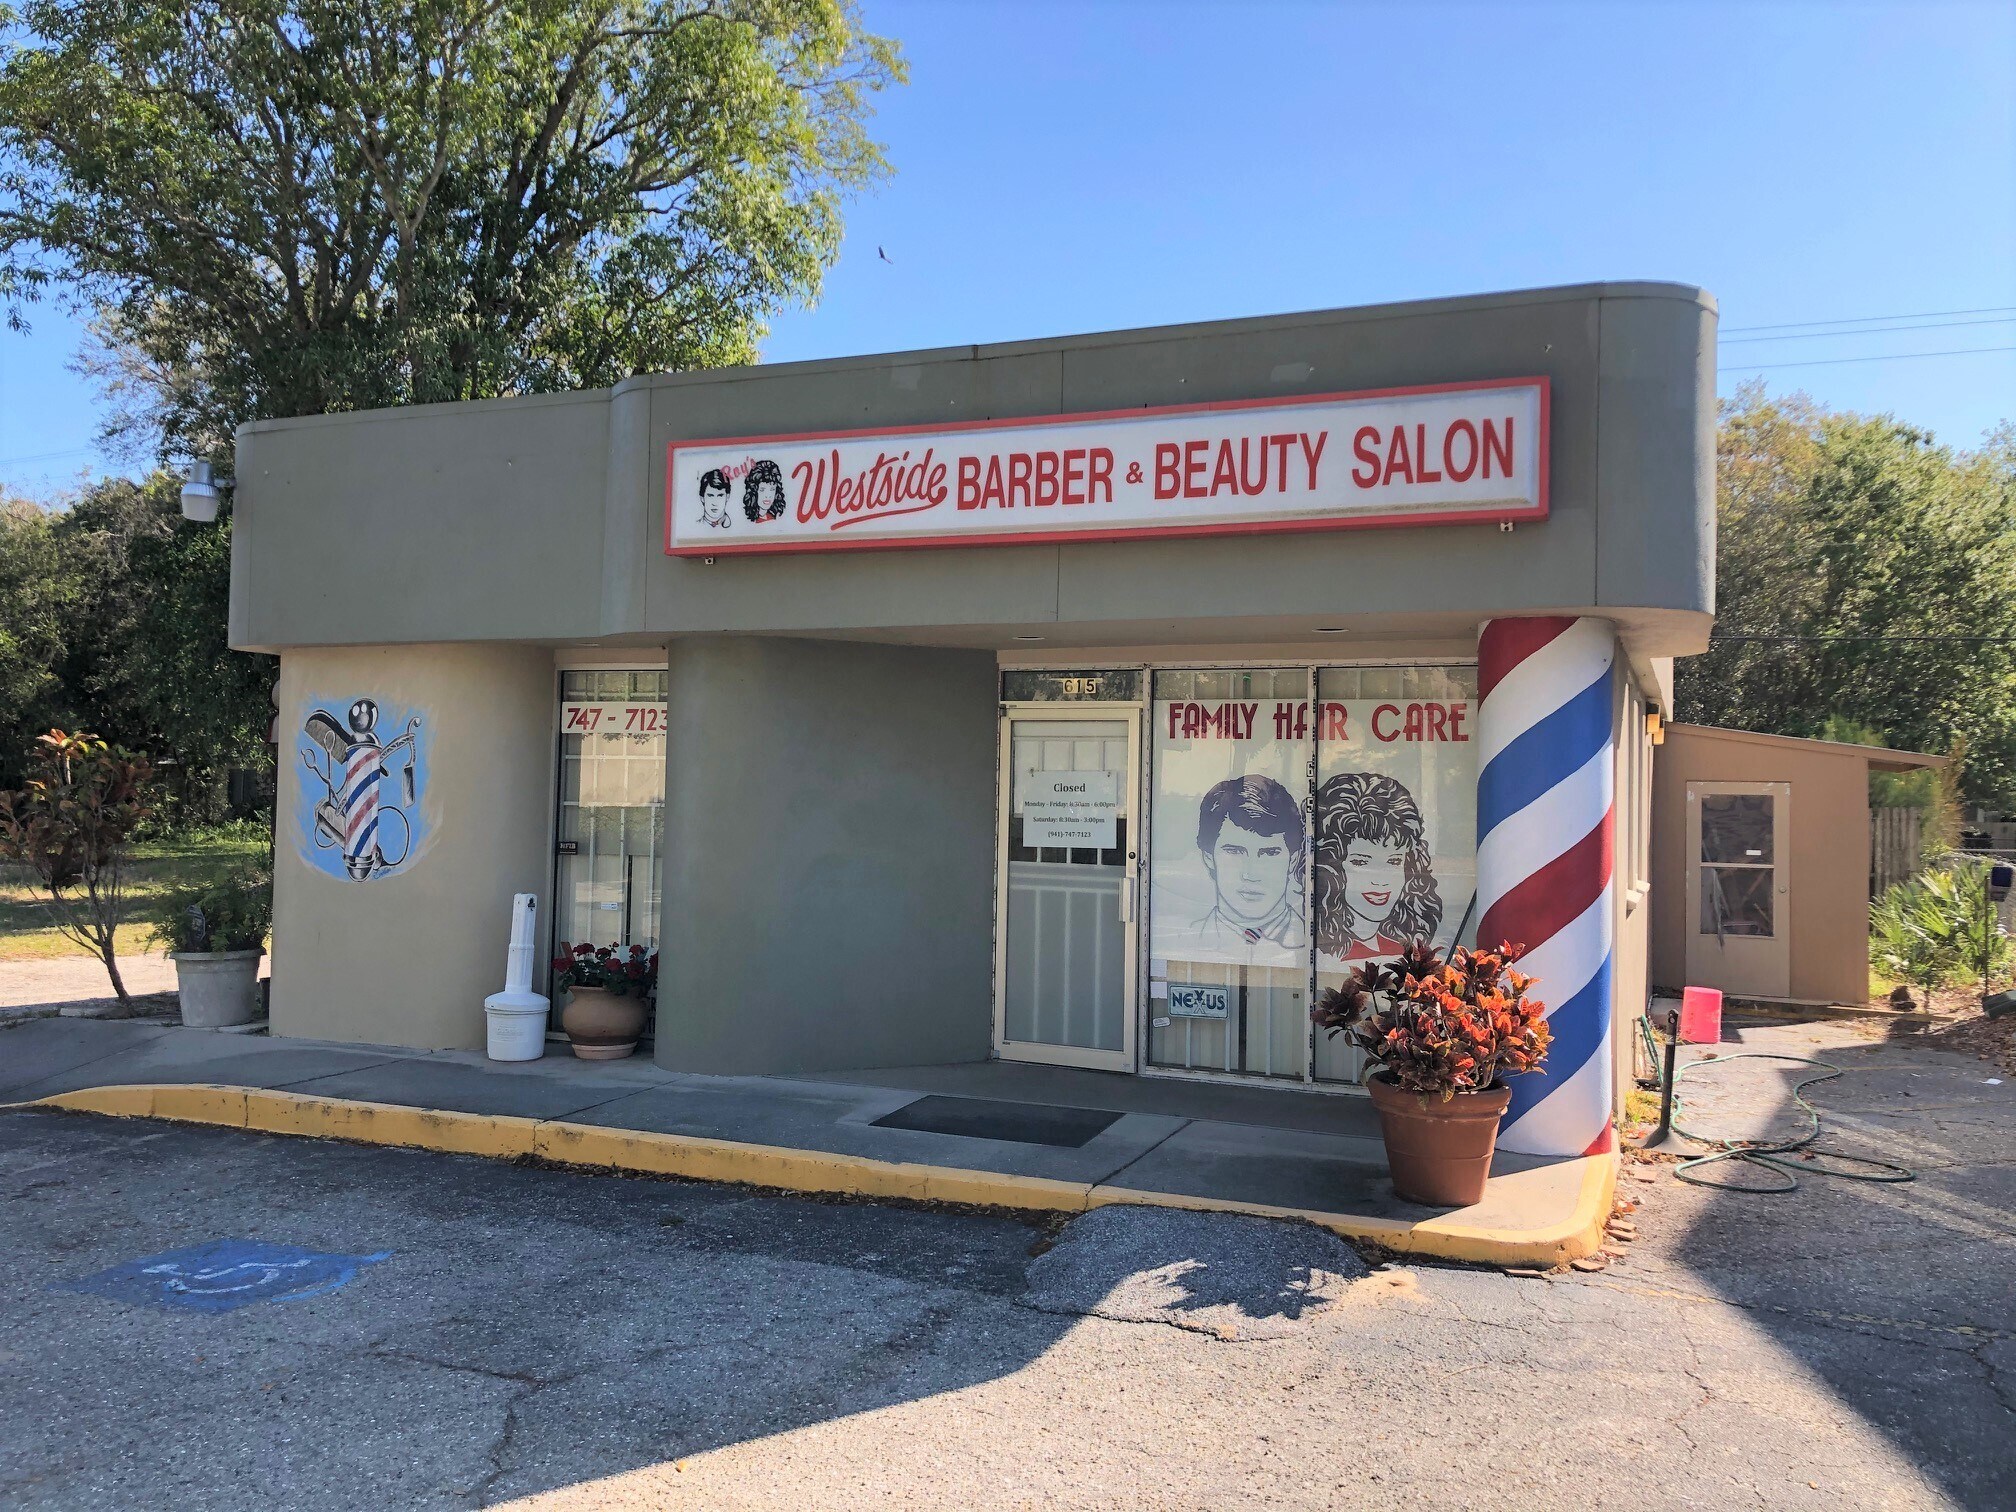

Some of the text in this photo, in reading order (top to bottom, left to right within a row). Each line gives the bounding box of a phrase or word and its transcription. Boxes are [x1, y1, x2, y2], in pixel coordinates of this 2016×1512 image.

[791, 417, 1514, 531] Westside BARBER & BEAUTY SALON
[1064, 679, 1095, 693] 615
[567, 708, 603, 731] 747
[1169, 702, 1469, 742] FAMILY HAIR CARE
[1053, 783, 1086, 793] Closed
[1033, 816, 1058, 824] Saturday:
